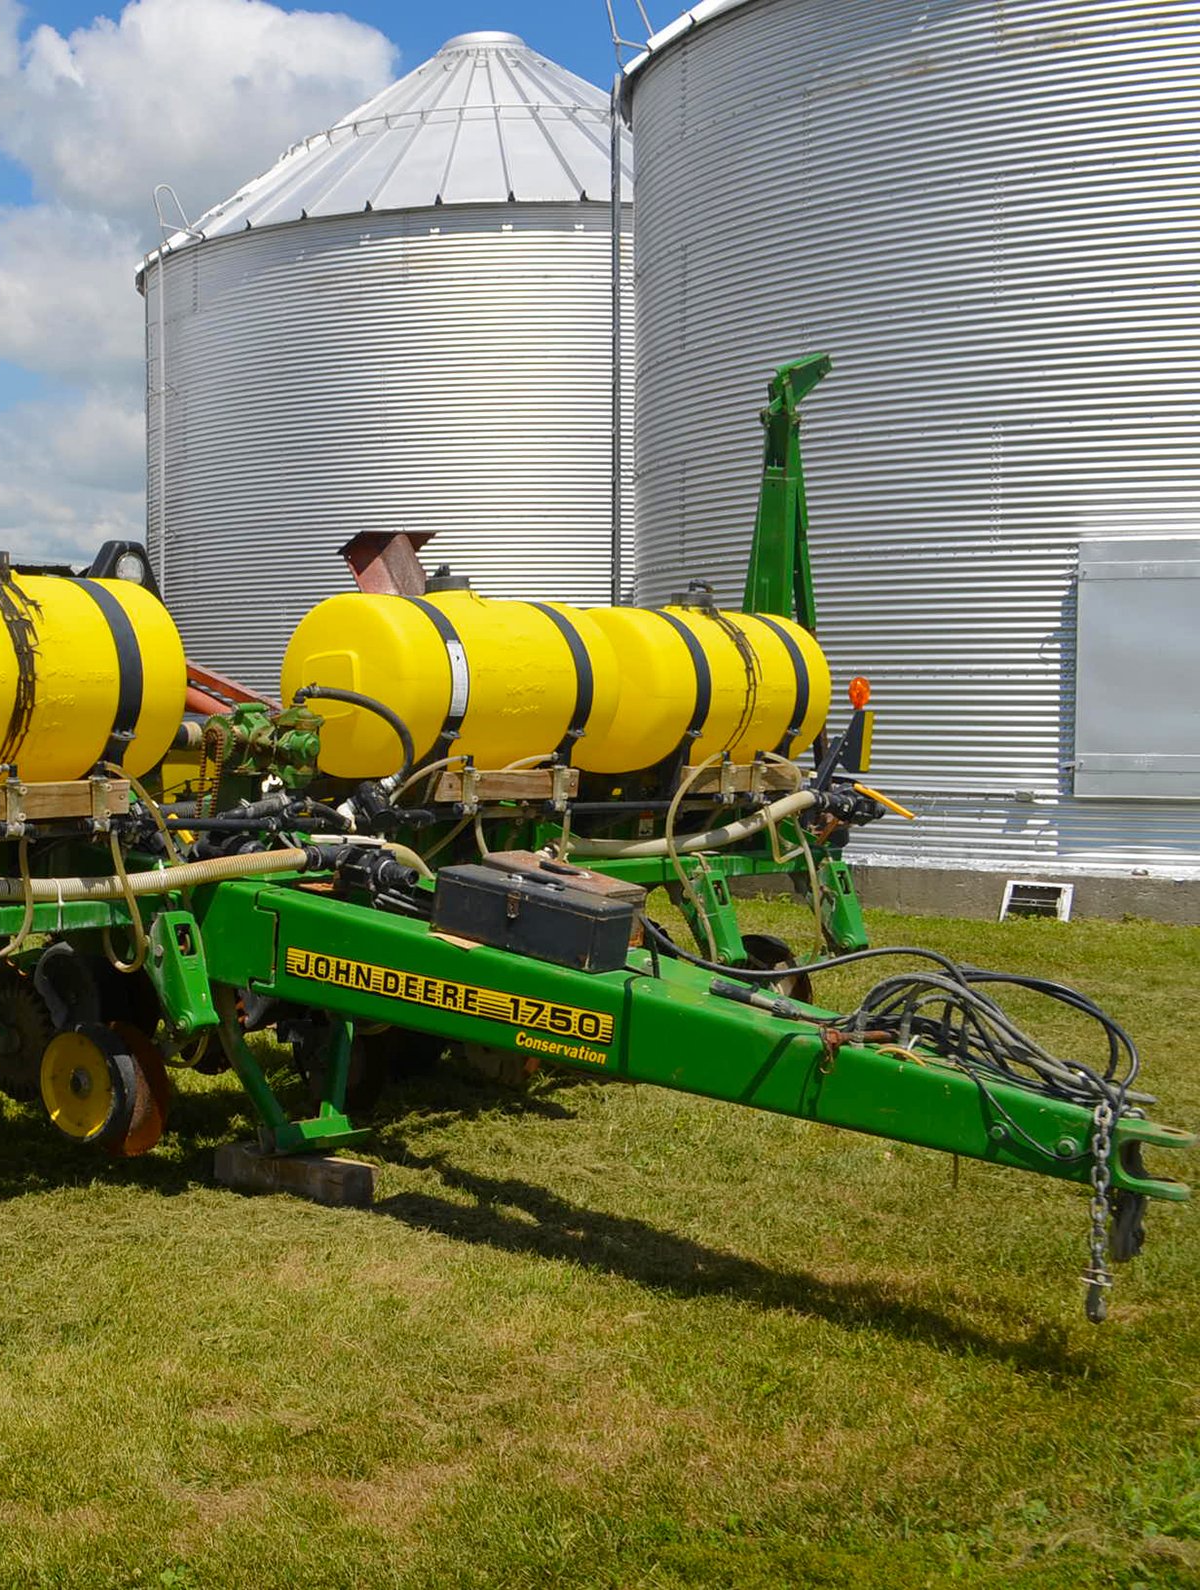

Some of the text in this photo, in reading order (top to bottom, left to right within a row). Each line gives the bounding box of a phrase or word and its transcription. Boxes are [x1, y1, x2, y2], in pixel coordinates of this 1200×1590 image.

[295, 953, 602, 1039] JOHN DEERE 1750
[515, 1030, 608, 1065] Conservation
